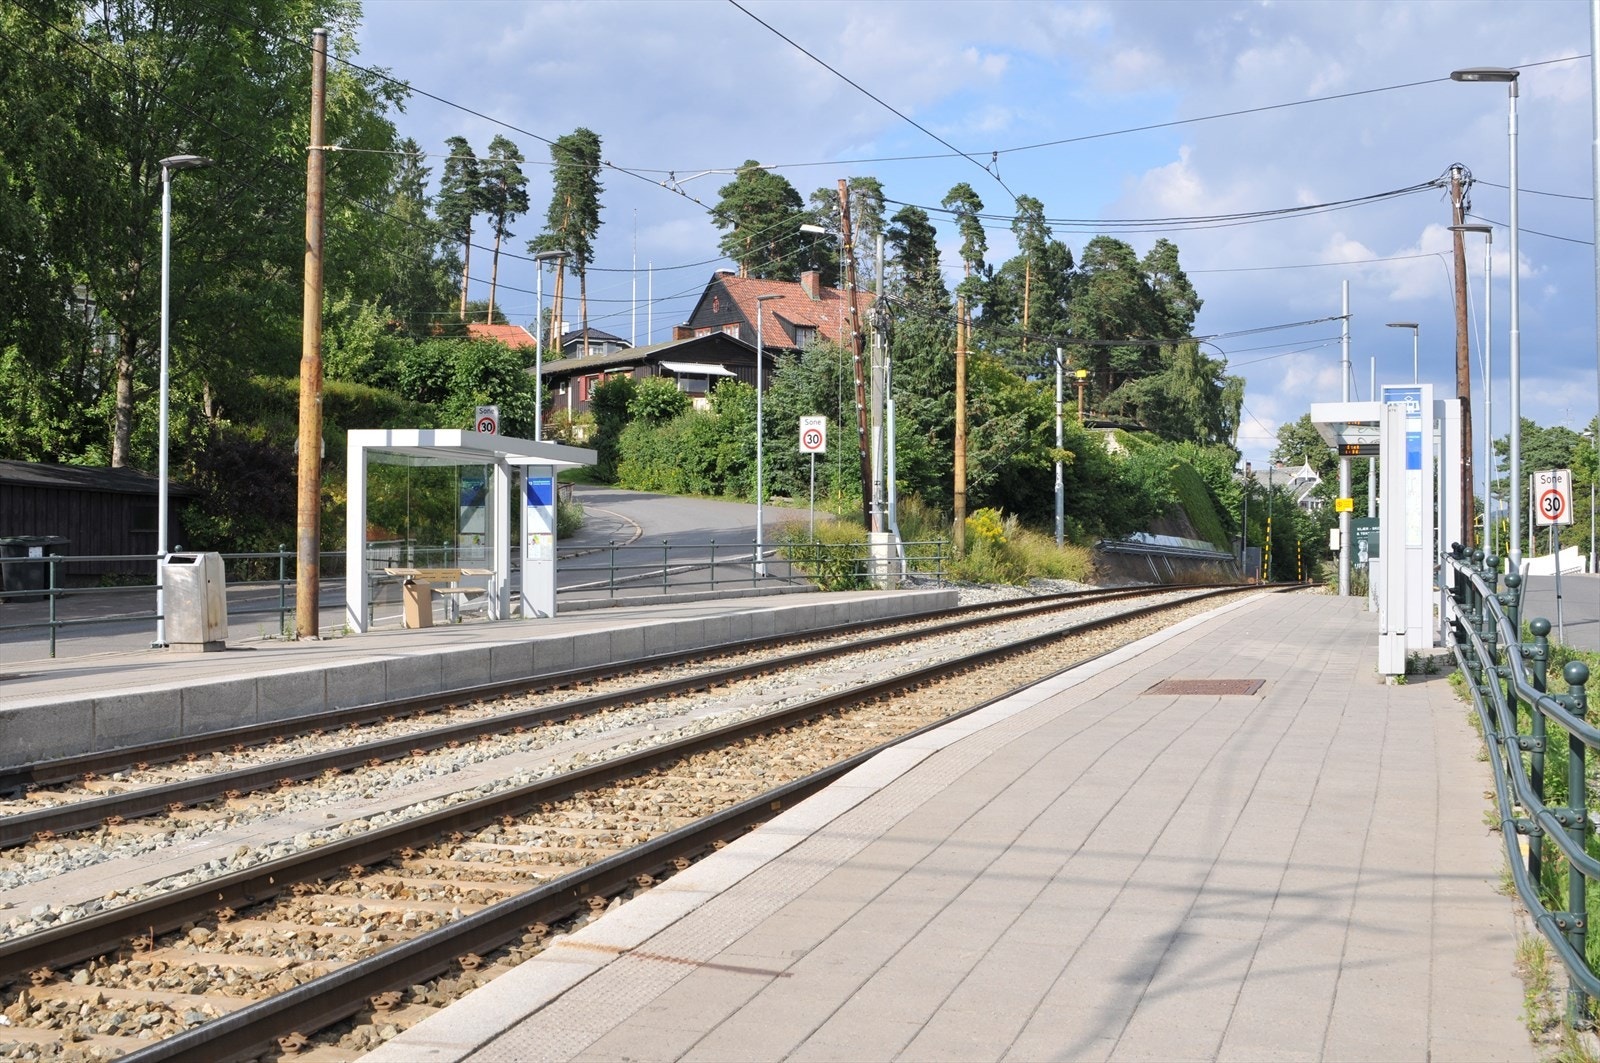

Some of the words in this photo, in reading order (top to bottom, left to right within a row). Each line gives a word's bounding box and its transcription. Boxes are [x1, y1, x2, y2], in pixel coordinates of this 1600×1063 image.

[481, 422, 492, 432] 30
[804, 418, 822, 426] Sone
[807, 434, 820, 445] 30
[1540, 474, 1562, 485] Sone
[1544, 497, 1561, 512] 30
